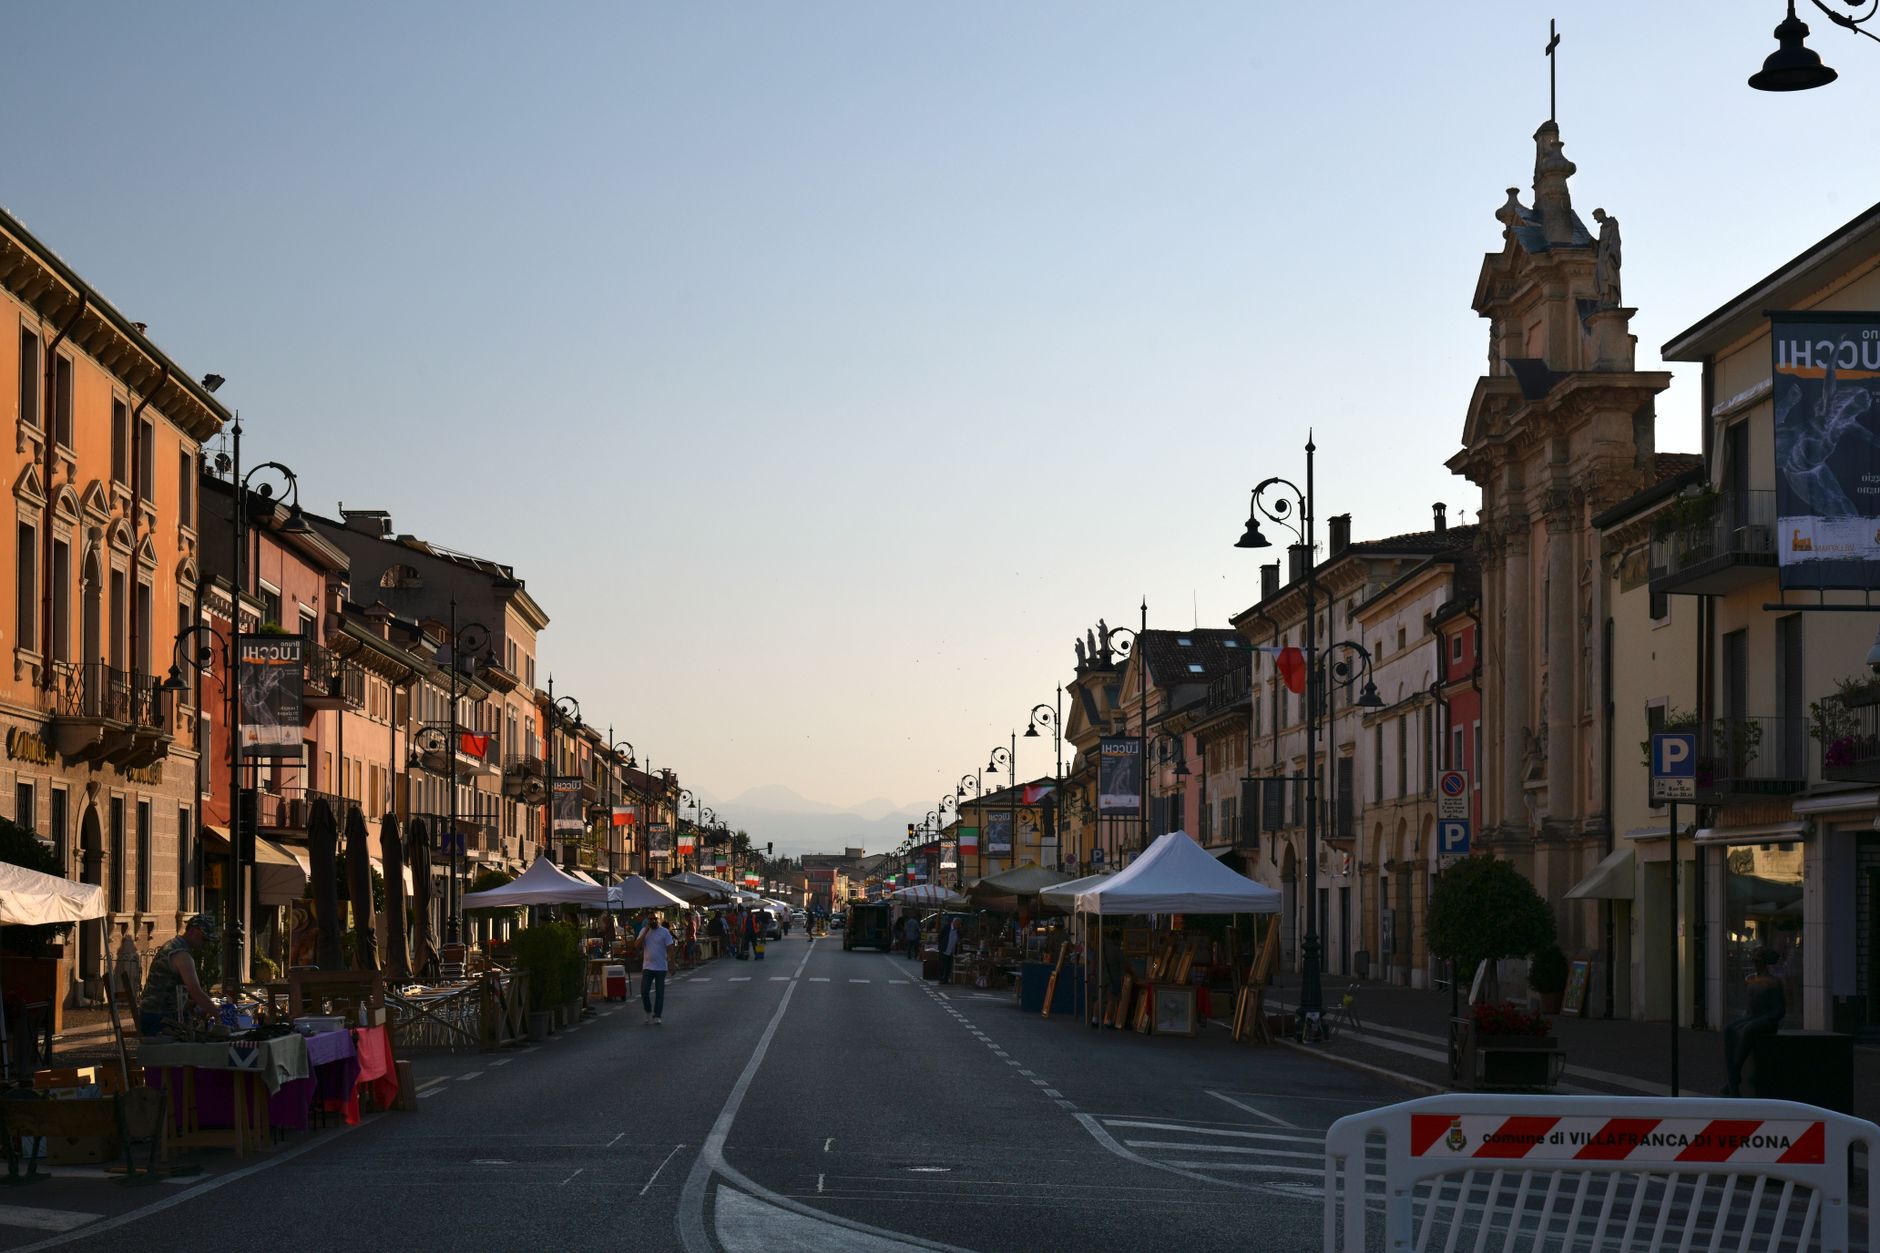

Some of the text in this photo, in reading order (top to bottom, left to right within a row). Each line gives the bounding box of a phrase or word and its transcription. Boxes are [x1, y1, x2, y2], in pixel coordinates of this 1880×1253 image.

[1662, 738, 1689, 773] P
[1445, 823, 1465, 850] P
[1093, 850, 1102, 862] P
[1482, 1130, 1791, 1149] comune di VILLAFRANCA DI VERONA
